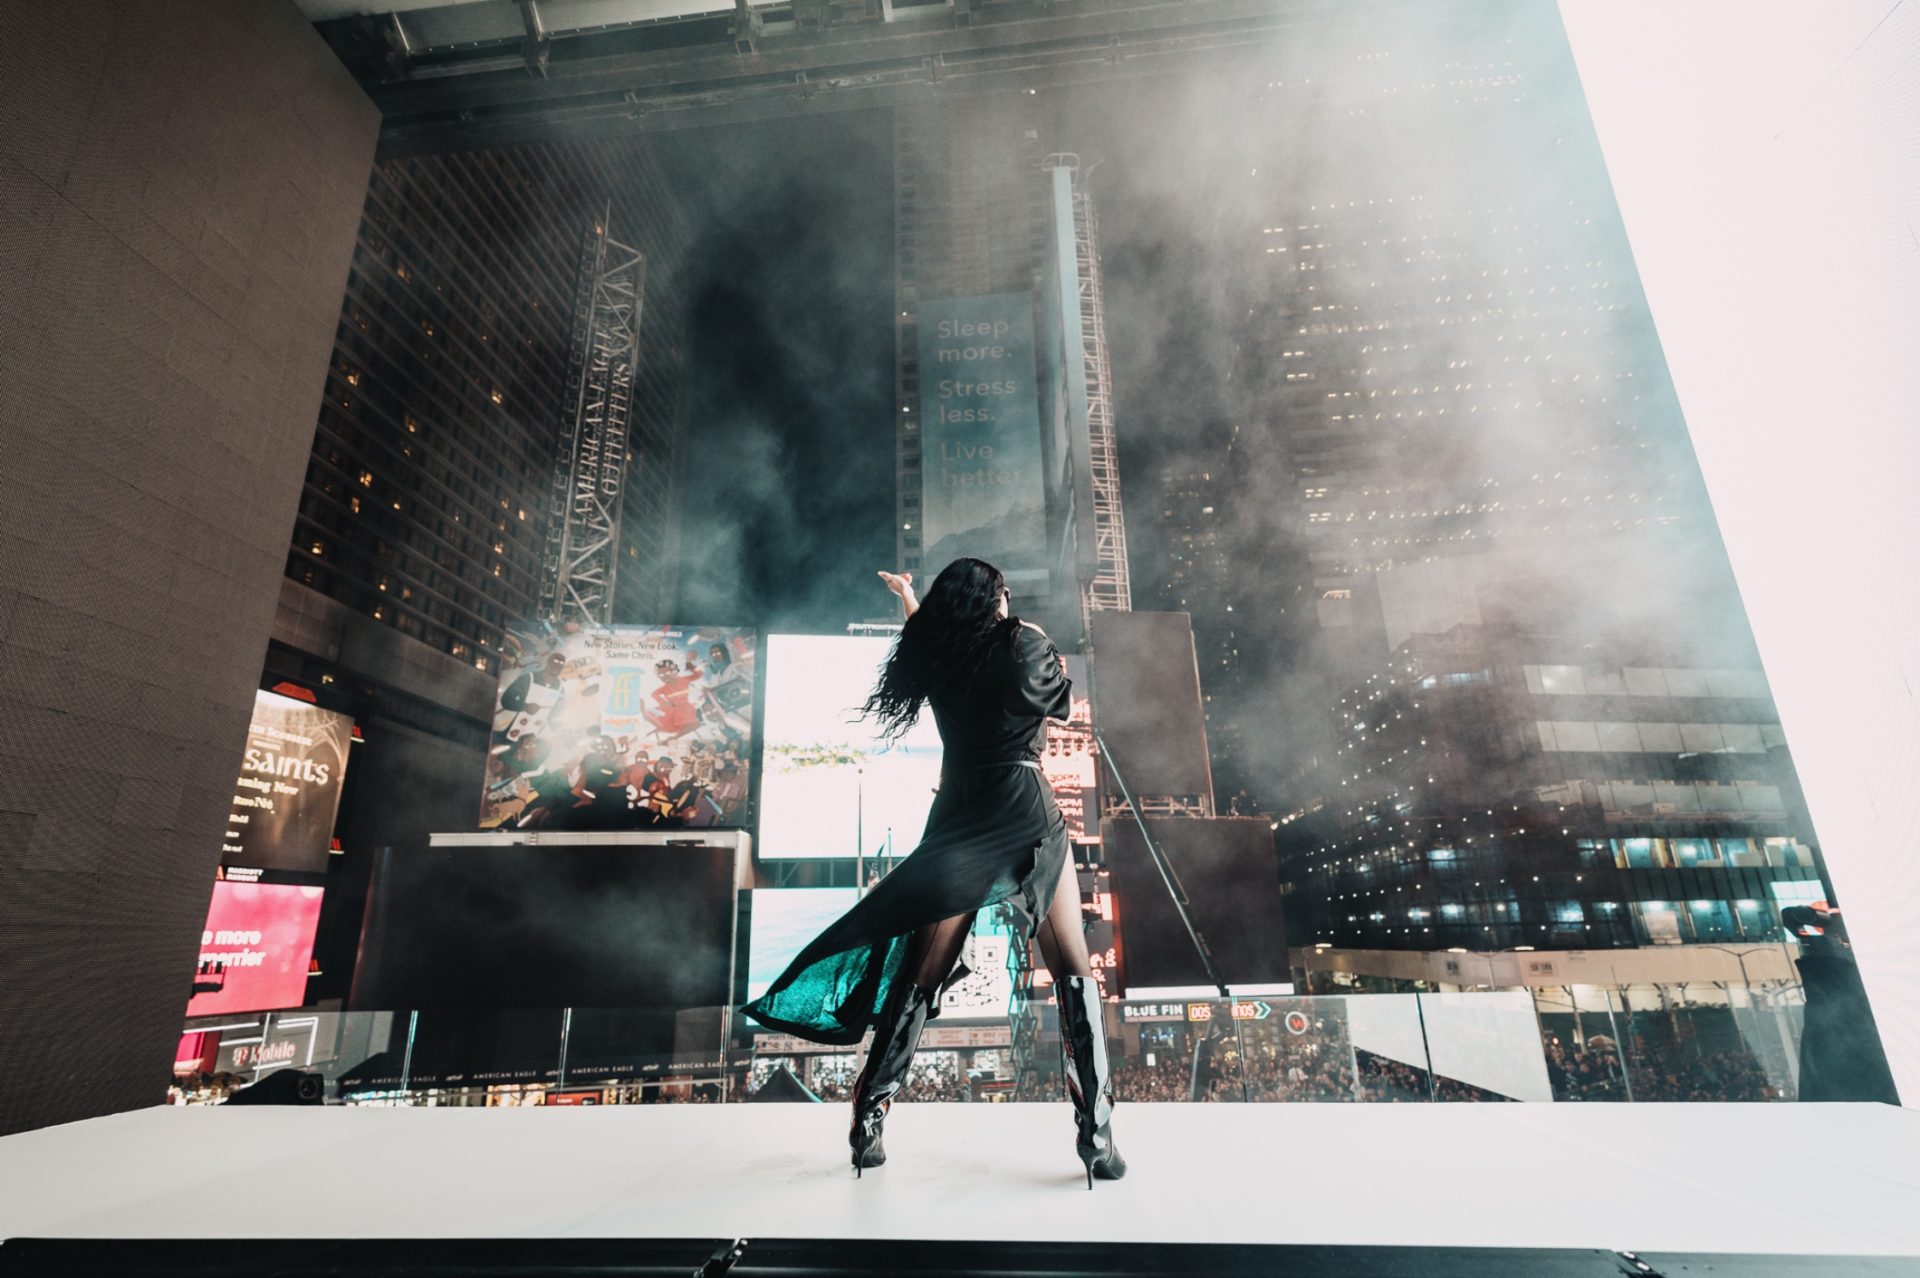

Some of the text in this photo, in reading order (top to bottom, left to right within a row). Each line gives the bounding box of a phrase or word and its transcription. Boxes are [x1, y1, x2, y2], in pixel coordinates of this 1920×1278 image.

[938, 320, 1009, 339] Sleep
[939, 345, 1012, 362] more.
[940, 380, 1016, 399] Stress
[940, 404, 996, 424] less.
[941, 440, 993, 461] Live
[584, 640, 602, 648] New
[638, 641, 656, 650] New
[606, 650, 629, 659] Same
[215, 930, 262, 945] more
[1124, 1004, 1183, 1016] BLUE FIN
